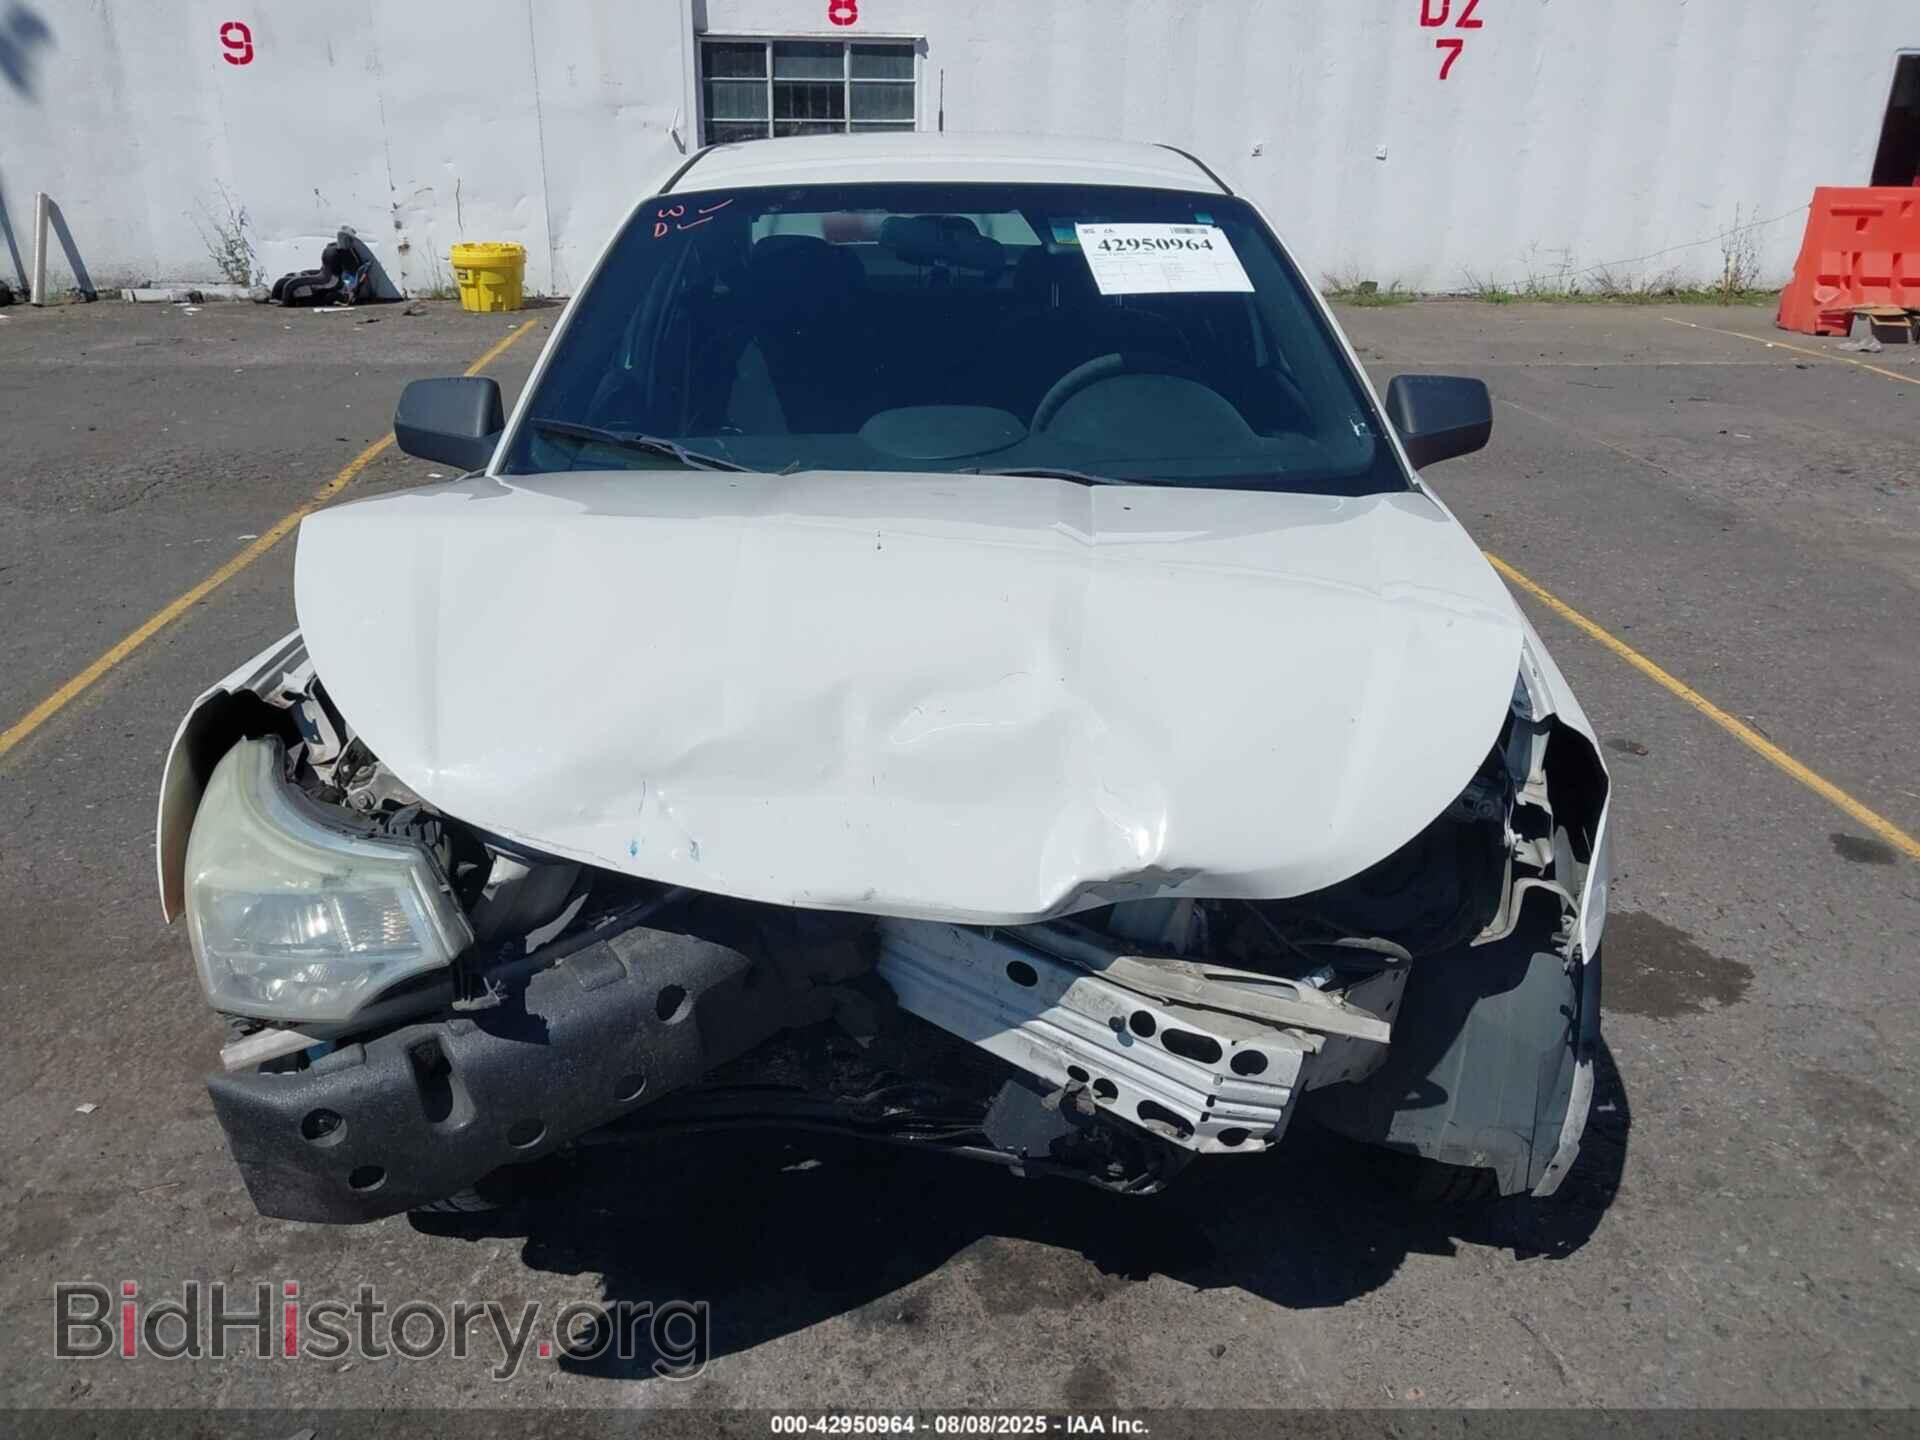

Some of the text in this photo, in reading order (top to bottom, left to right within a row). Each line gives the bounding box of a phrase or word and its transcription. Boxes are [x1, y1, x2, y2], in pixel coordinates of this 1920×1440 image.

[828, 0, 859, 27] 8
[220, 21, 254, 65] 9
[1436, 38, 1464, 80] 7
[1097, 237, 1214, 252] 42950964
